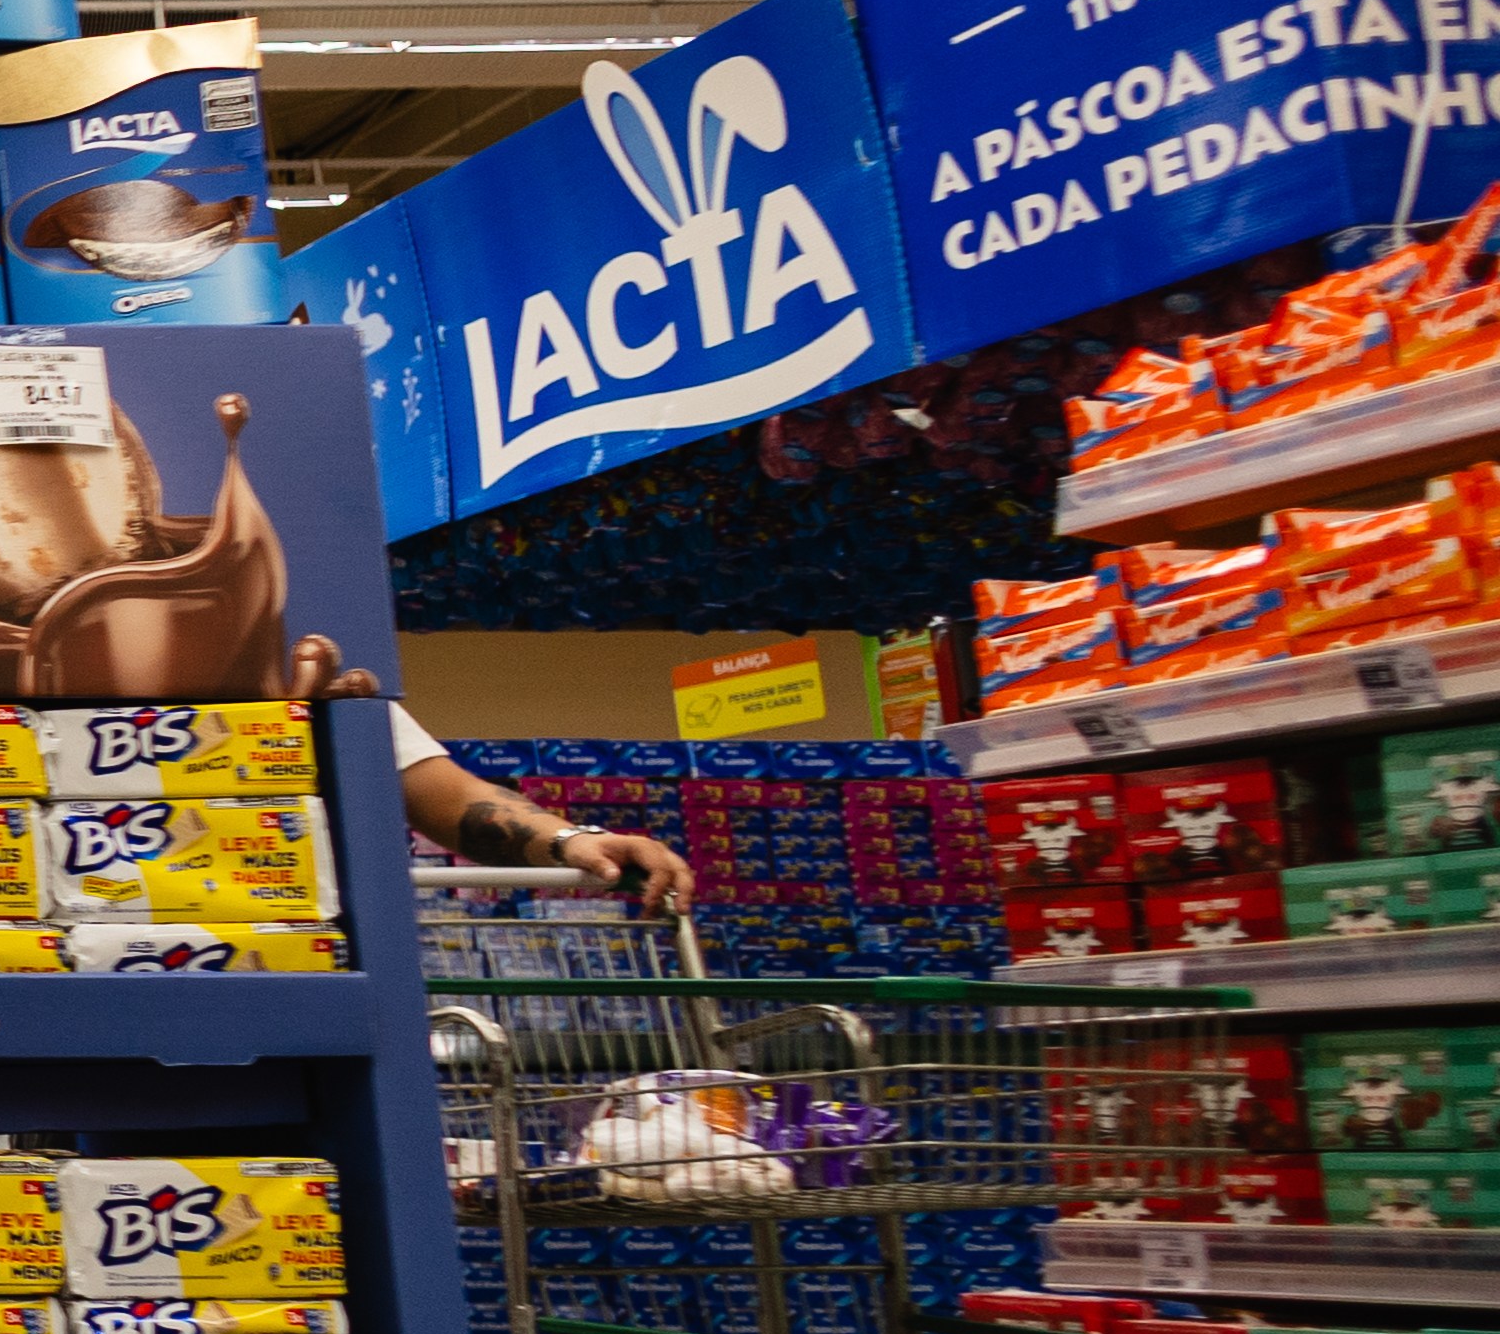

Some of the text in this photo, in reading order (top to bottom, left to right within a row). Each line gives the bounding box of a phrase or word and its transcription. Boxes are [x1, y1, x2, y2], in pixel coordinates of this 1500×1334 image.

[70, 111, 190, 152] LACTA
[931, 151, 972, 202] A
[973, 50, 1214, 182] PÁSCOA
[943, 179, 1102, 270] CADA
[464, 185, 874, 492] LACTA
[713, 652, 771, 676] BALANÇA
[94, 710, 193, 770] BIS
[106, 1190, 216, 1257] BIS
